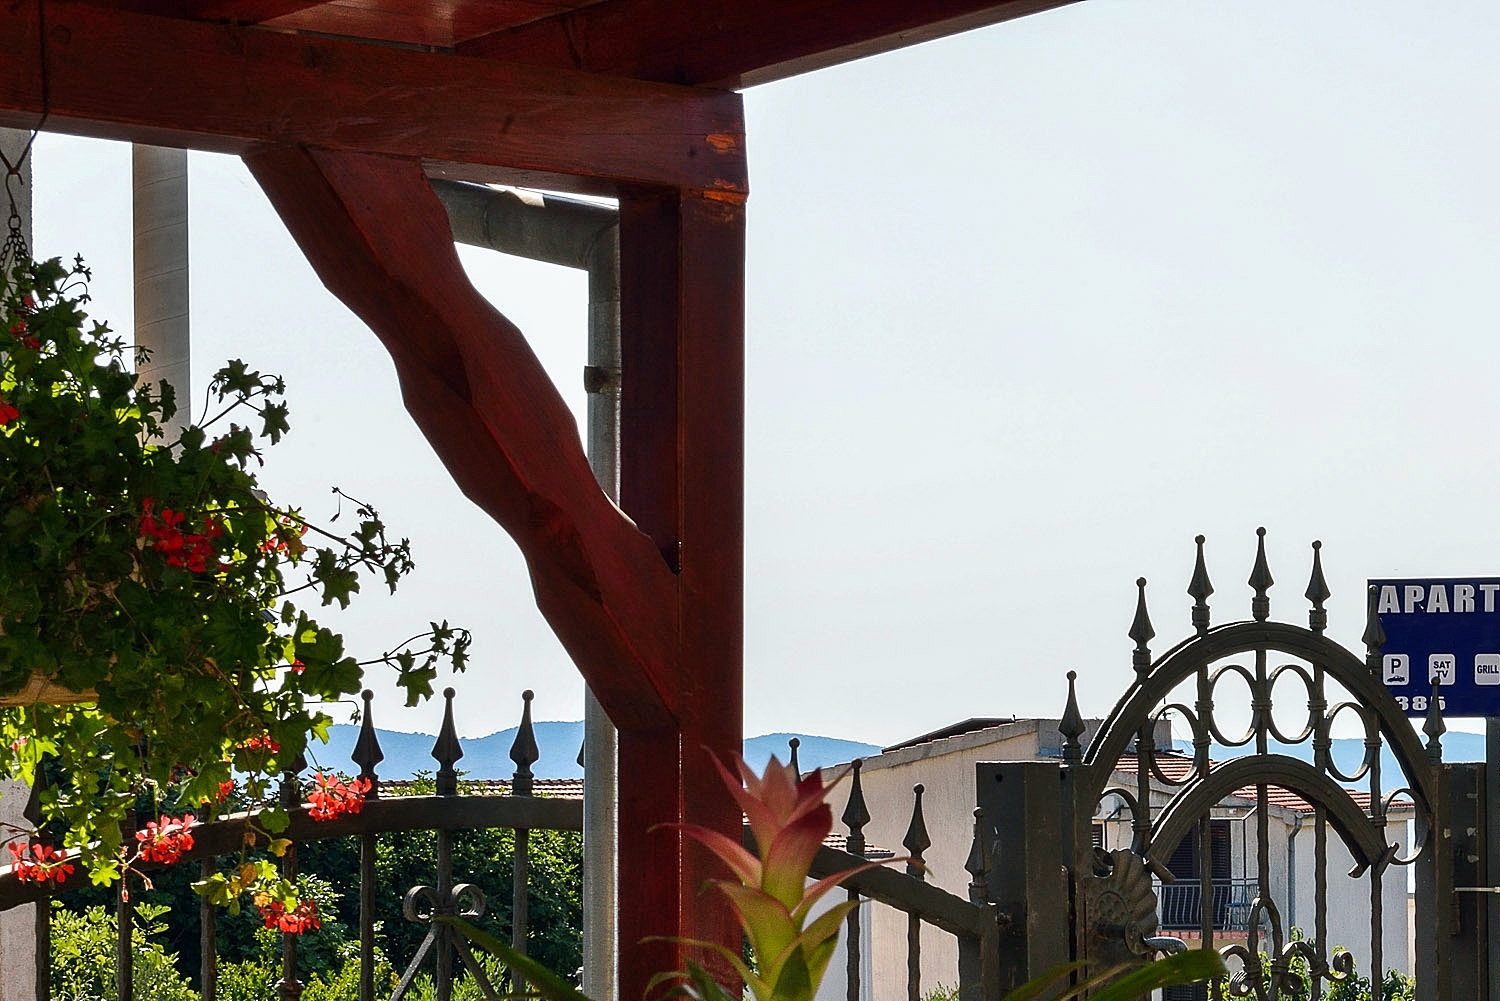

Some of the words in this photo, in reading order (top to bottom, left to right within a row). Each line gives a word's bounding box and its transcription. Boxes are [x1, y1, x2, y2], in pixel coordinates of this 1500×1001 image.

[1391, 658, 1402, 674] P
[1433, 660, 1451, 669] SAT
[1477, 664, 1500, 674] GRILL
[1435, 670, 1449, 678] TV
